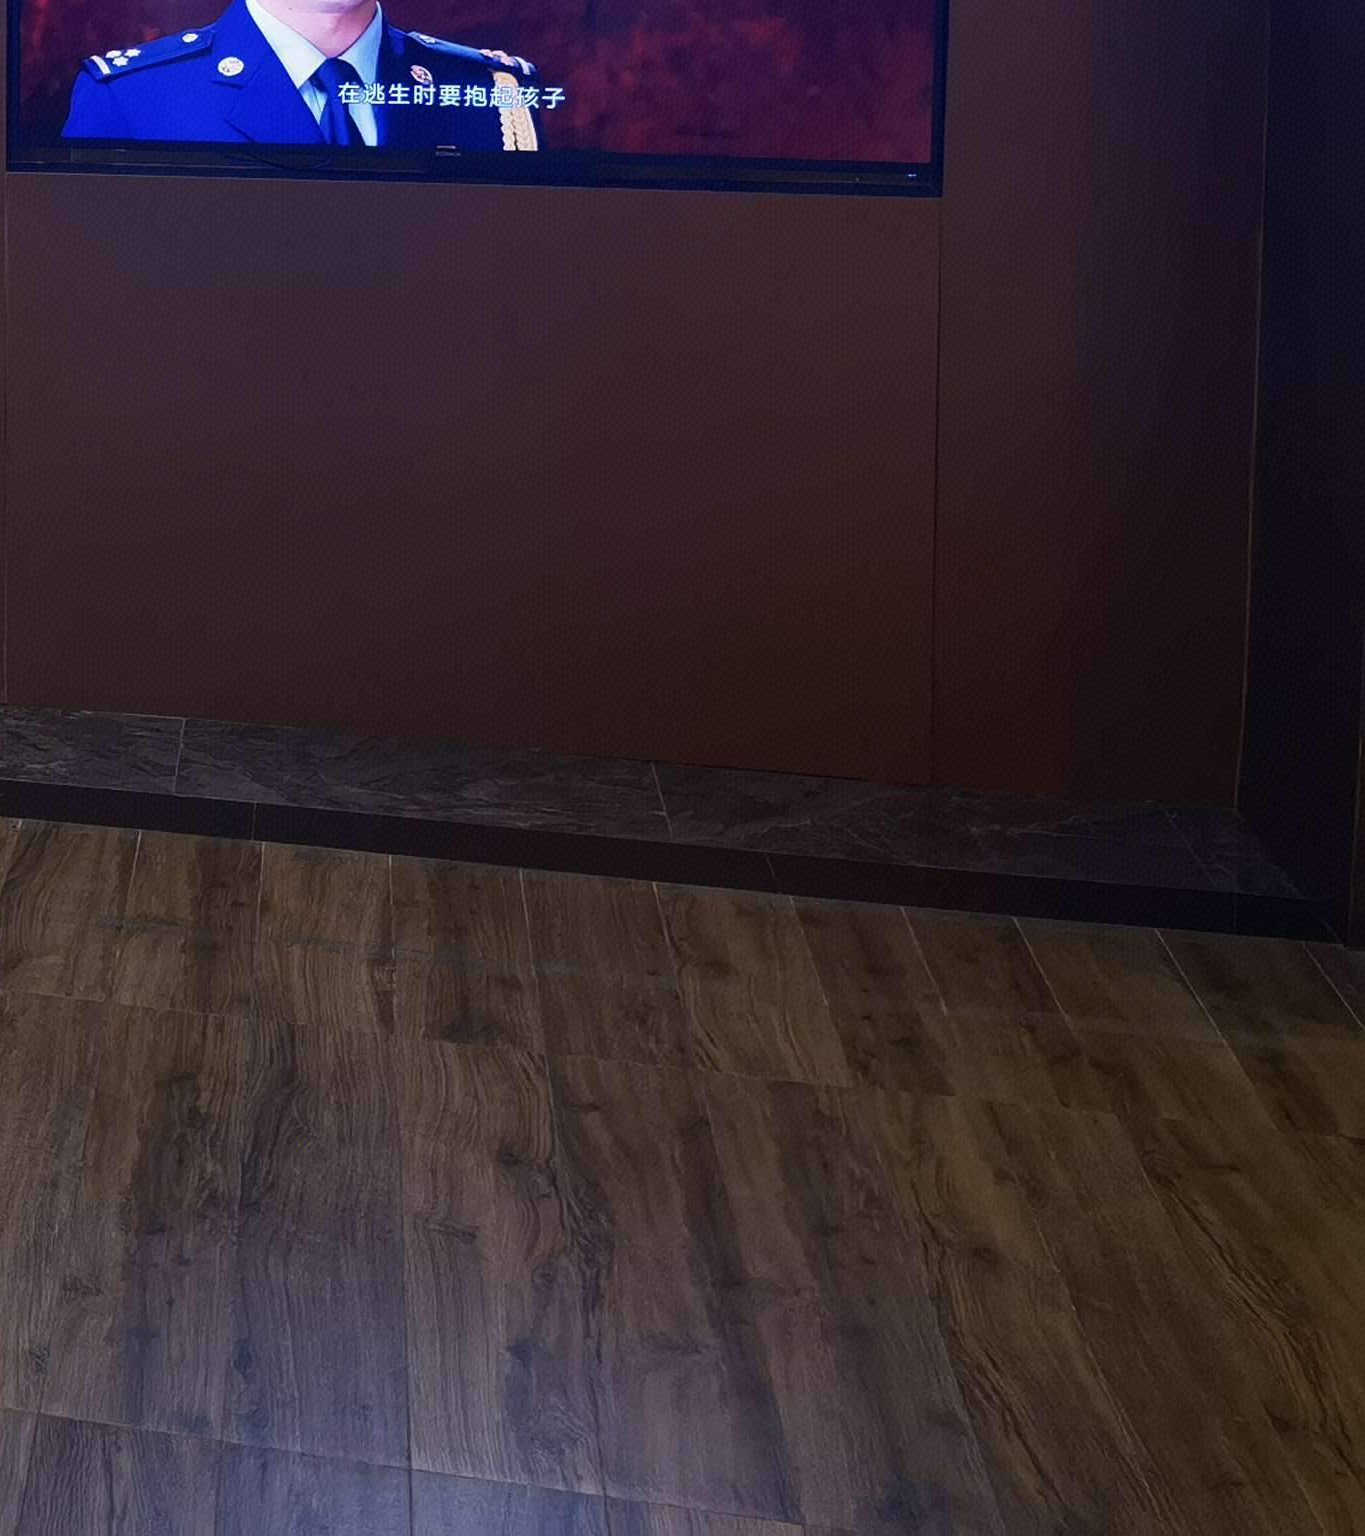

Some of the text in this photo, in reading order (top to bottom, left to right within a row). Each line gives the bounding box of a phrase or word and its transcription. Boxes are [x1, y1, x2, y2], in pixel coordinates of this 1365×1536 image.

[337, 81, 566, 110] 在逃生时要抱起孩子
